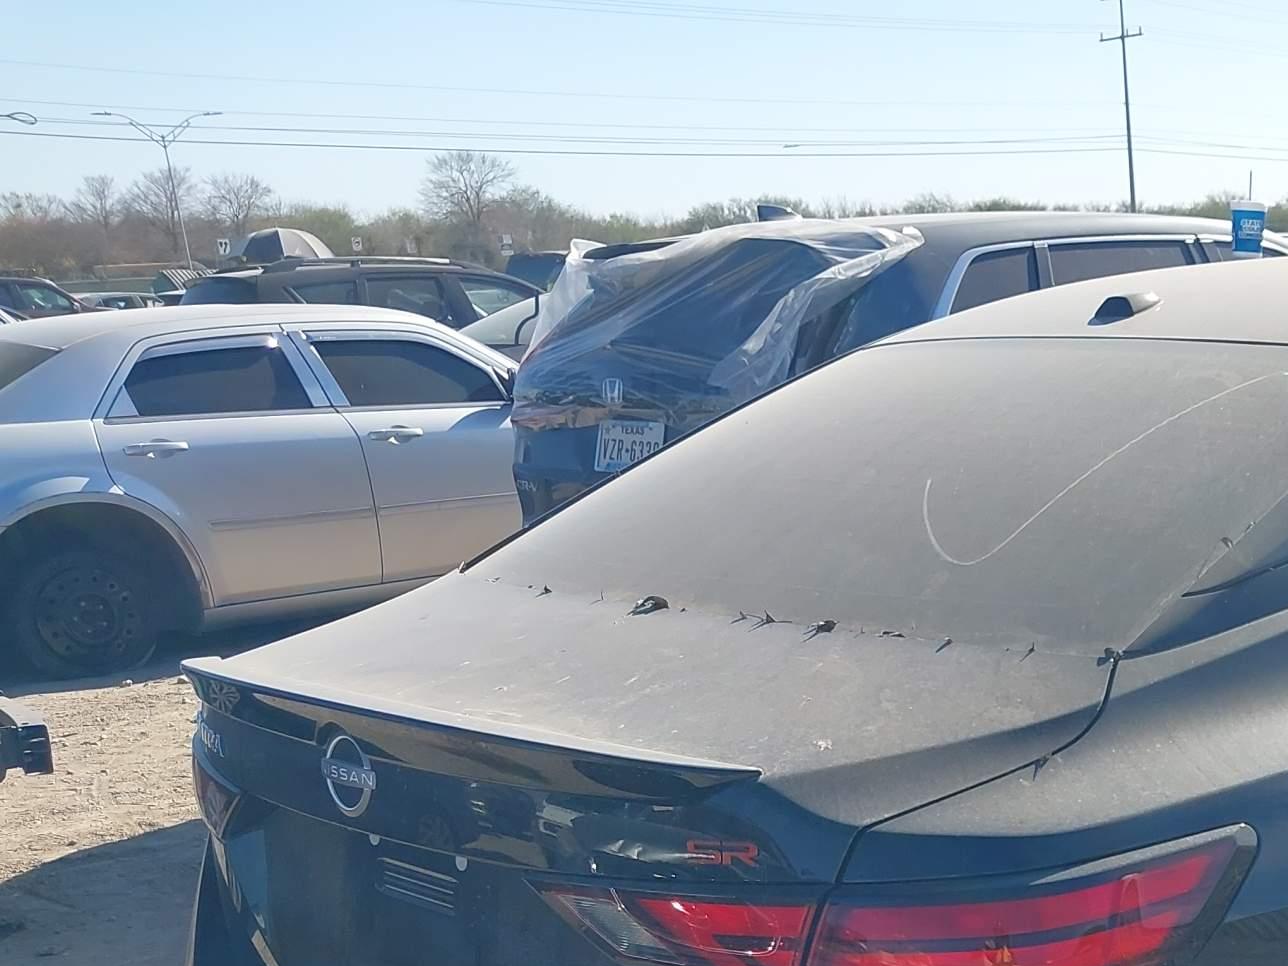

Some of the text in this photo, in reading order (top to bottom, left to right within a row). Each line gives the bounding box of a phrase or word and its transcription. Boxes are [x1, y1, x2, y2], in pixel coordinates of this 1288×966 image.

[620, 424, 646, 436] TEXAS
[516, 479, 538, 492] CR-V
[686, 839, 760, 867] SR
